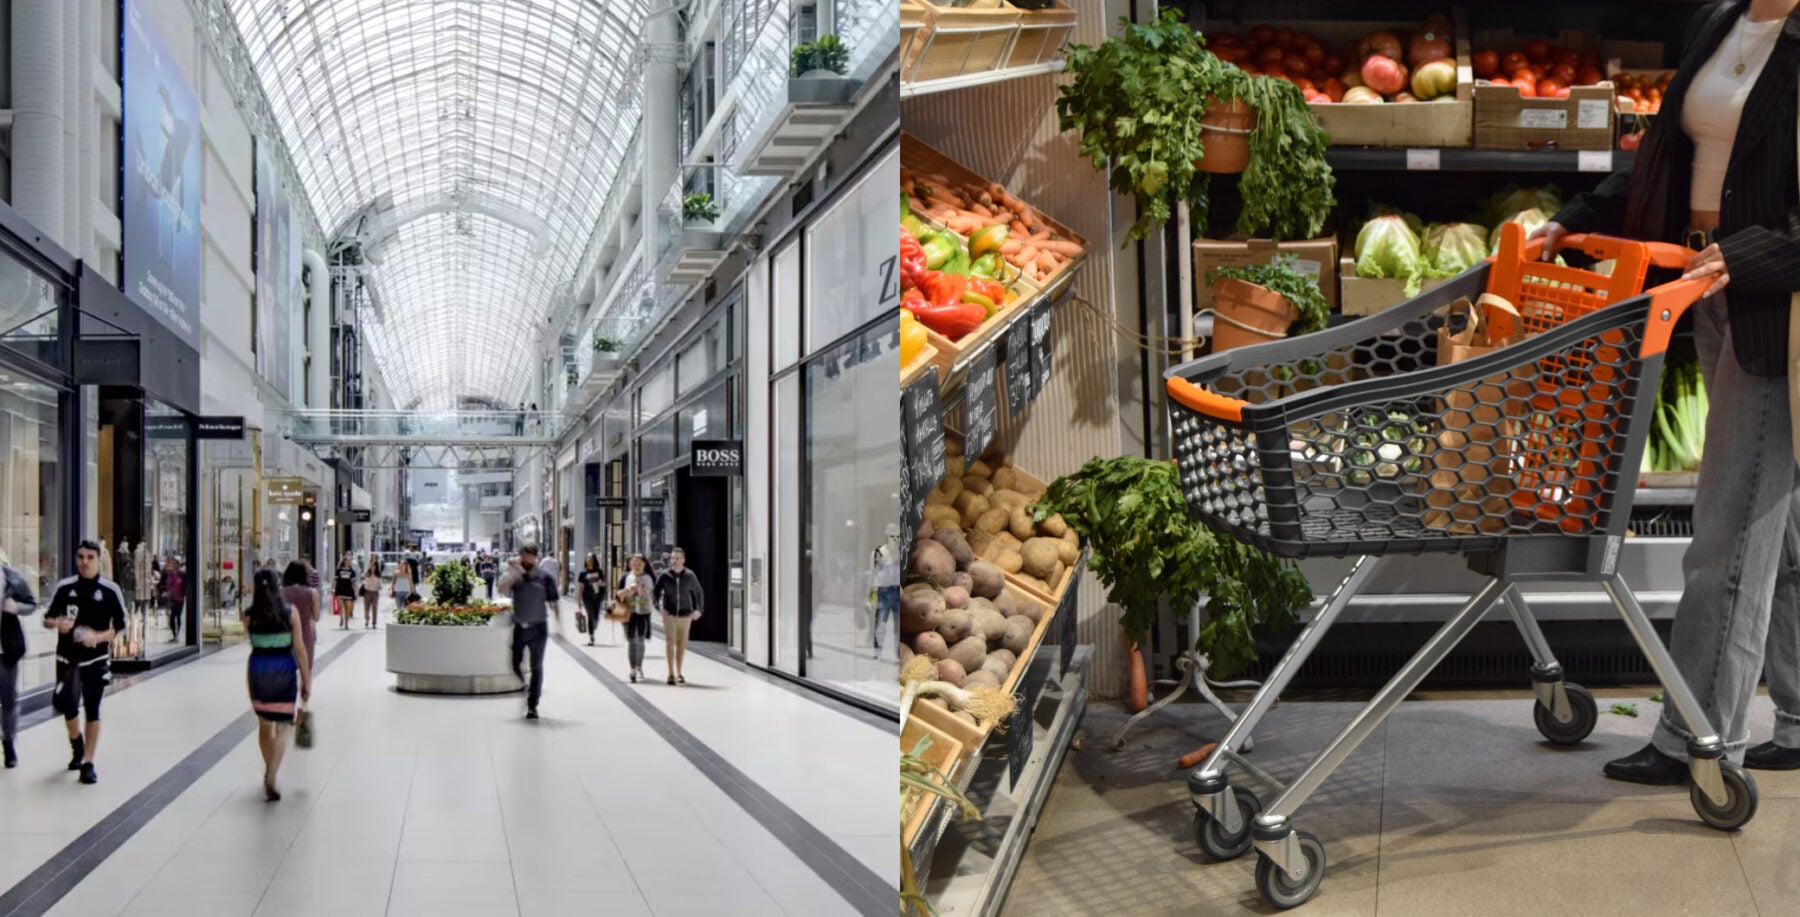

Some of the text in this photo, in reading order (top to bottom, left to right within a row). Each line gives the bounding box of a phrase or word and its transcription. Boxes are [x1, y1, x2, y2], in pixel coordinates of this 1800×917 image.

[878, 254, 897, 305] Z
[198, 423, 242, 431] Mackage
[696, 449, 740, 462] BOSS
